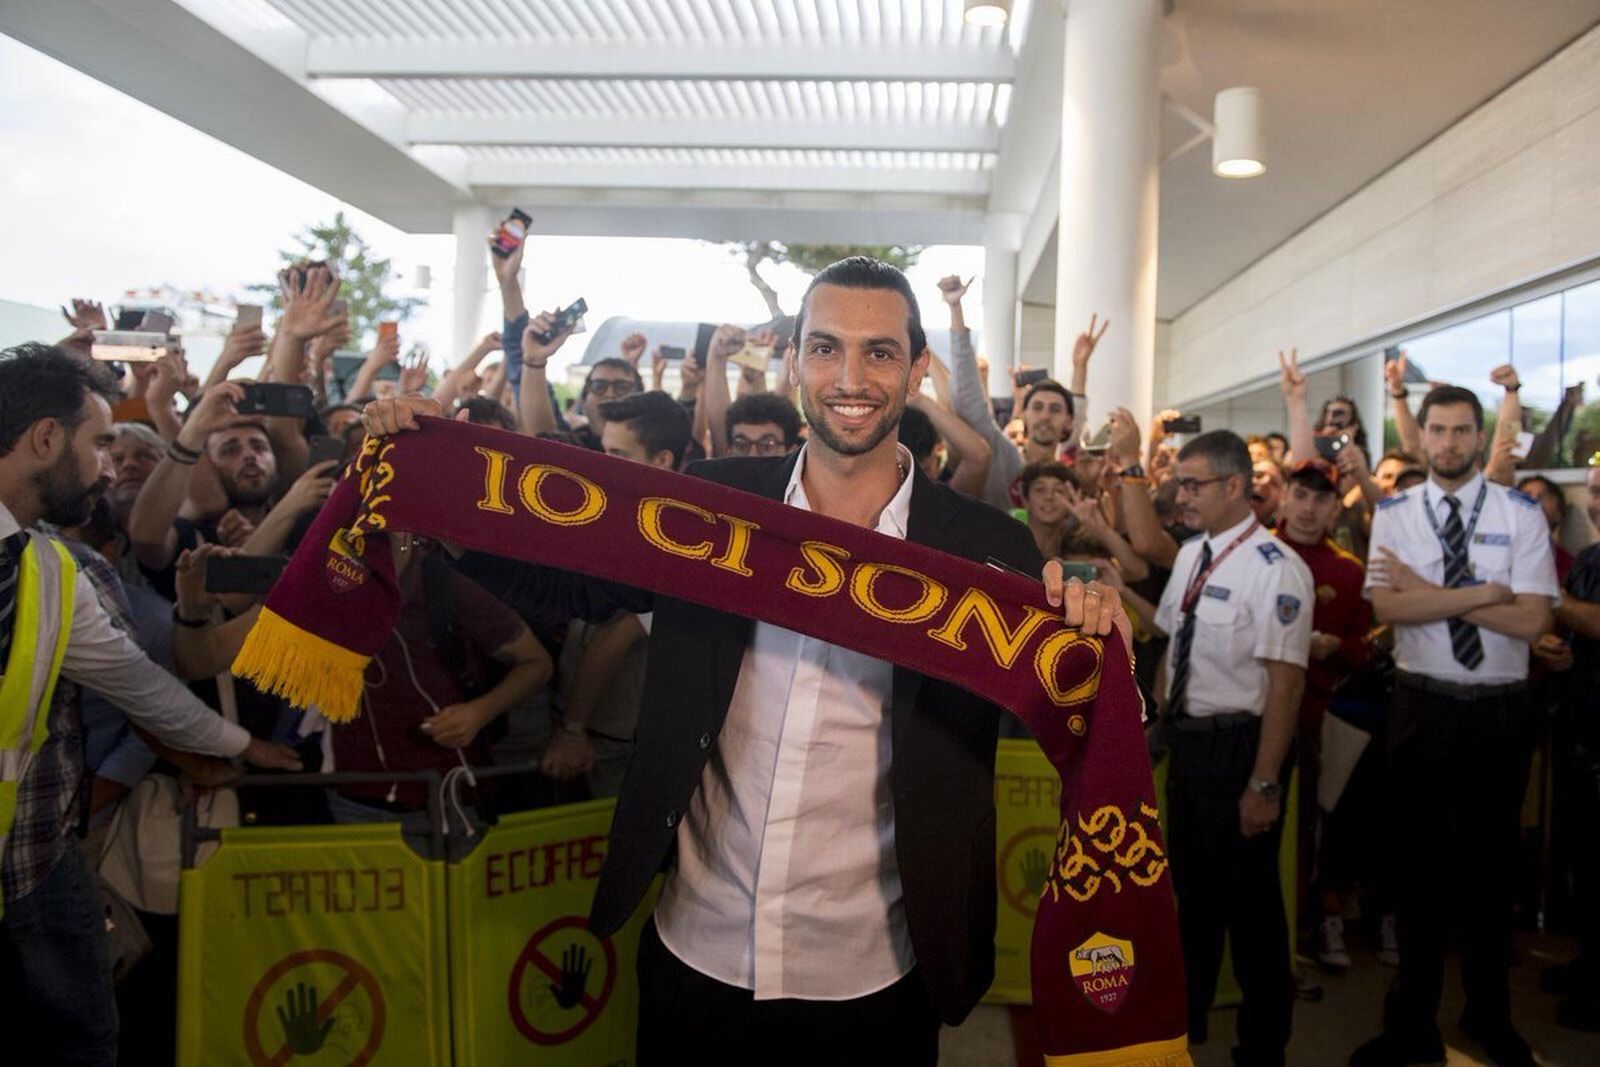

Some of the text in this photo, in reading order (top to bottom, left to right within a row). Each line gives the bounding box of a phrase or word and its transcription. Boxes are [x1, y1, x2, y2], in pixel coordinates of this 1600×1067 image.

[475, 446, 607, 526] IO
[637, 496, 760, 577] CI
[326, 557, 364, 585] ROMA
[485, 833, 610, 898] ECOFAS
[1083, 974, 1129, 994] ROMA
